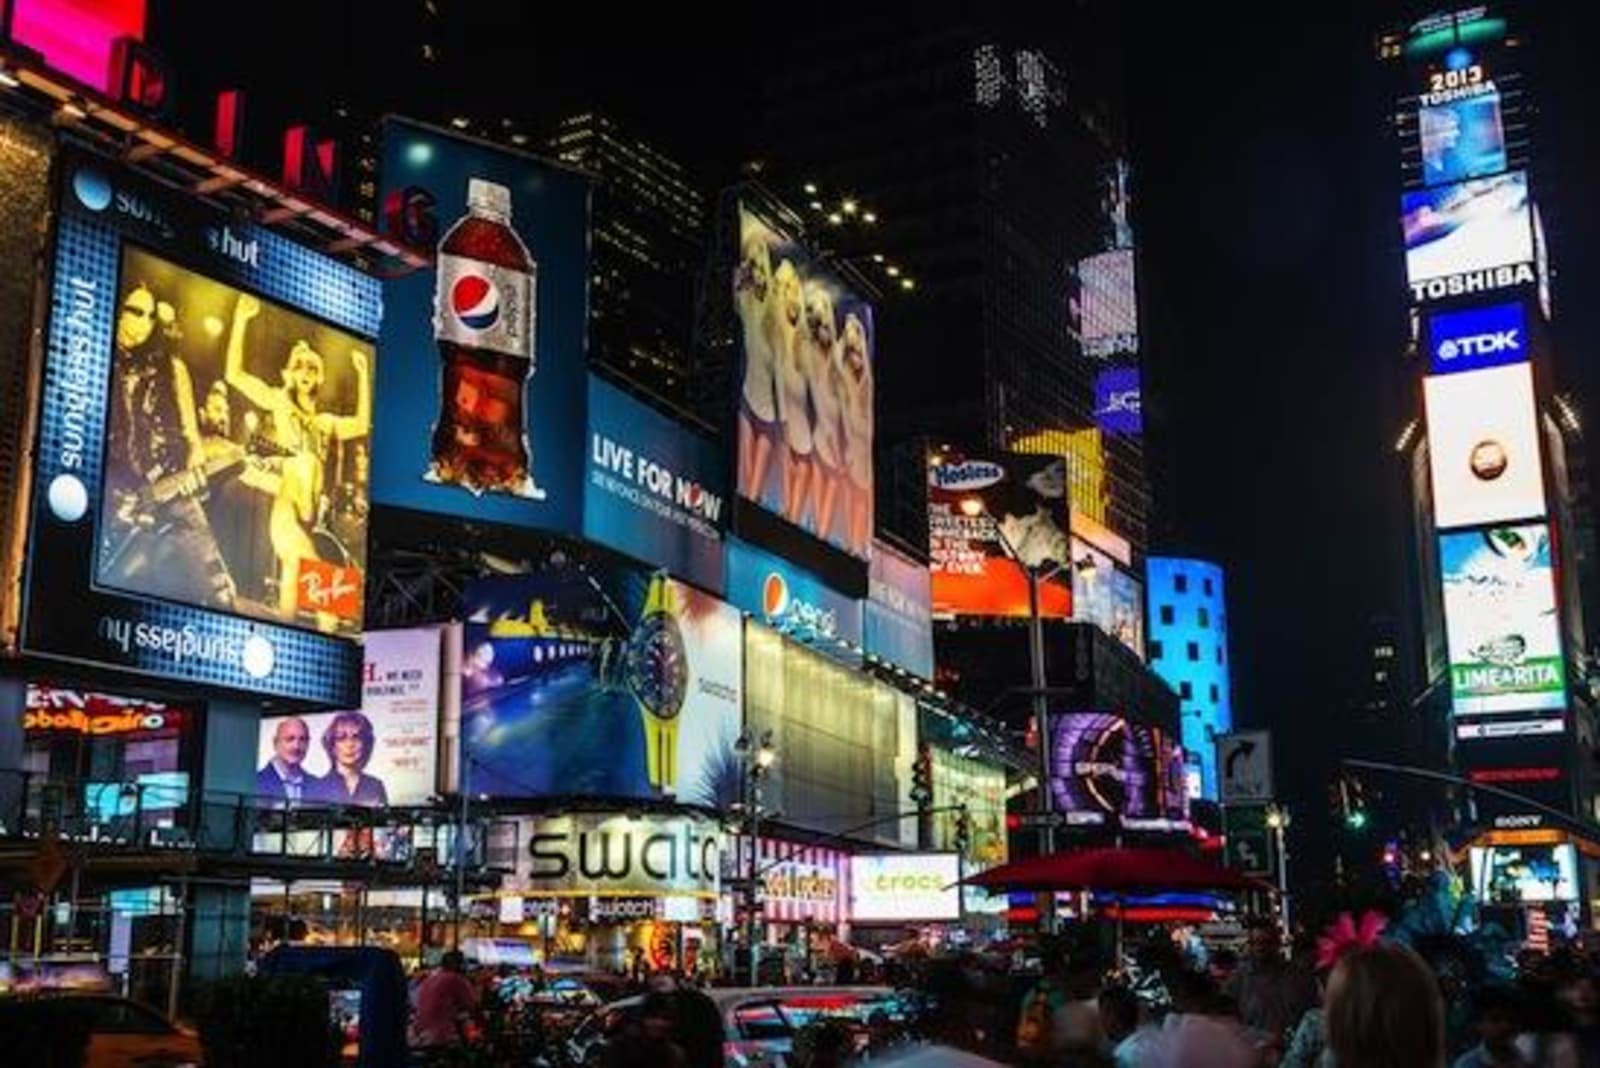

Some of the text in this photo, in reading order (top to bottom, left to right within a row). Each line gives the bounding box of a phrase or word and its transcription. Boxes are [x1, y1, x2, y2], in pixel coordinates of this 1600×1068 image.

[1419, 80, 1496, 106] TOSHIBA
[1431, 66, 1483, 91] 2013
[221, 225, 260, 267] hut
[1410, 263, 1536, 301] TOSHIBA
[1456, 329, 1520, 356] TDK
[60, 276, 97, 469] sunglass hut
[593, 433, 633, 479] LIVE
[637, 456, 673, 499] FOR
[675, 476, 722, 522] NOW
[135, 622, 235, 664] sunglass
[1494, 815, 1542, 828] SONY
